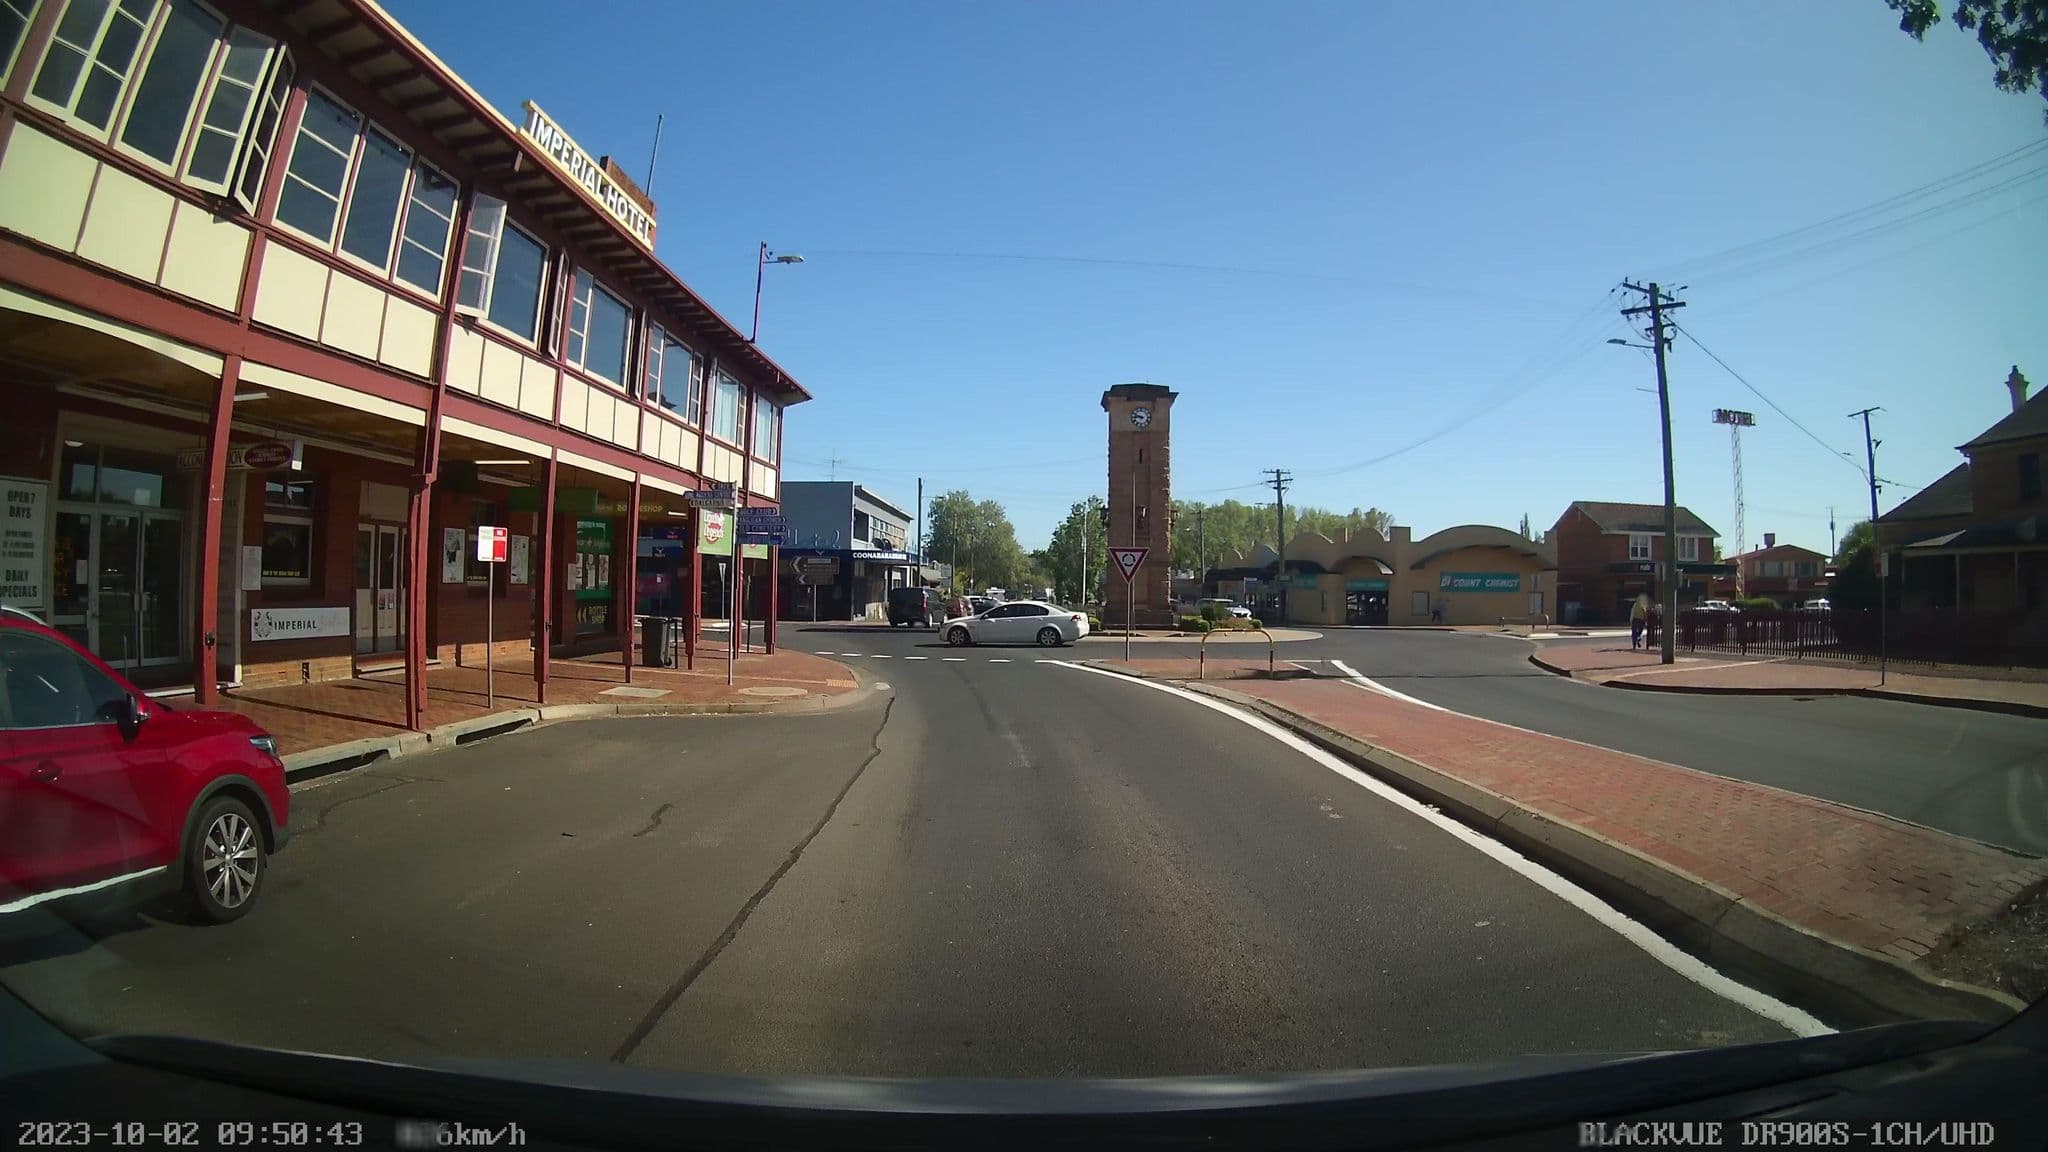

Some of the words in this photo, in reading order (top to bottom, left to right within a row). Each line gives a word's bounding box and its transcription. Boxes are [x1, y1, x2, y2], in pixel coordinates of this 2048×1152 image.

[529, 110, 606, 202] IMPERIAL
[606, 187, 652, 244] HOTEL
[1717, 408, 1756, 426] MOTEL
[9, 505, 32, 519] DAYS
[616, 503, 663, 513] BOESHOP
[6, 569, 29, 582] DAILY
[0, 585, 37, 598] PECIALS
[274, 620, 317, 631] IMPERIAL
